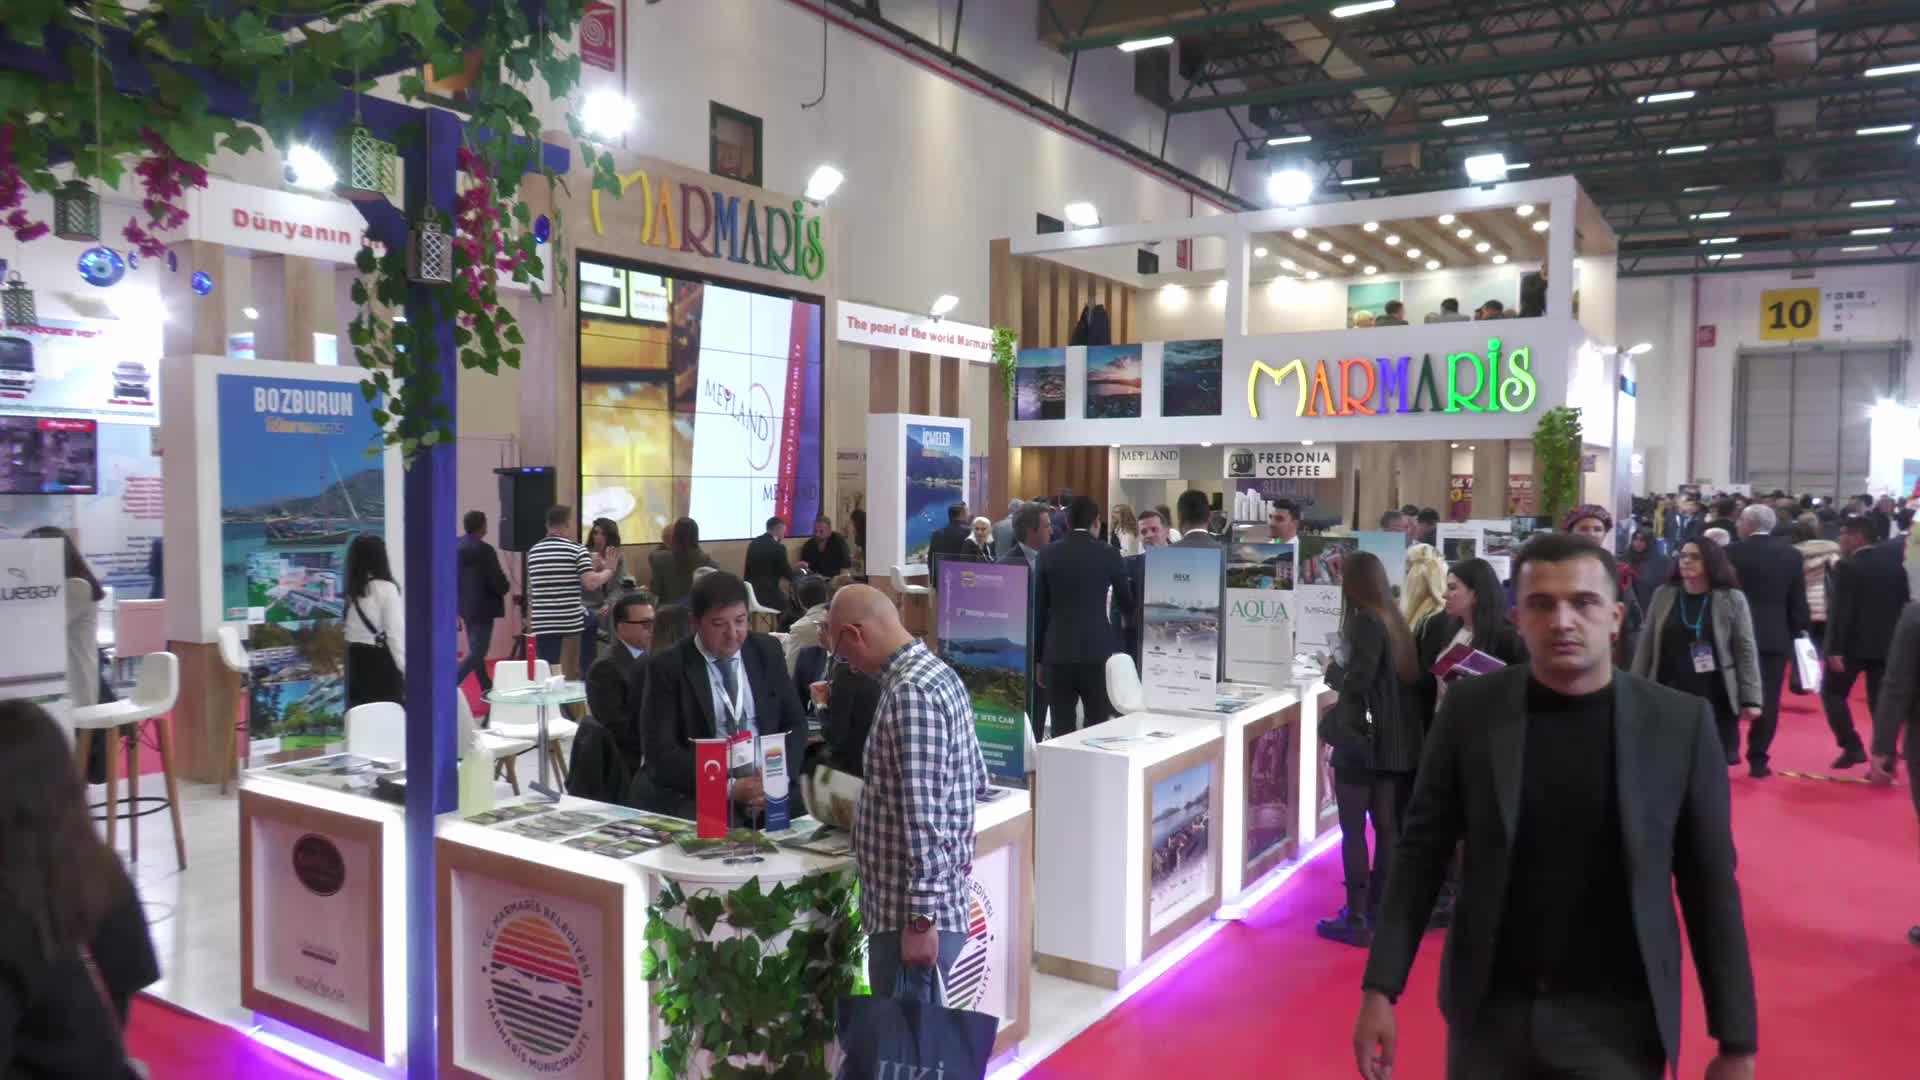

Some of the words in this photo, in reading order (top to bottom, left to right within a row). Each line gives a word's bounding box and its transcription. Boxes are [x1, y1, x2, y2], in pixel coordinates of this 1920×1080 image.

[232, 207, 351, 245] Dünyanın
[1768, 300, 1813, 329] 10
[847, 315, 868, 331] The
[870, 322, 897, 337] pearl
[899, 325, 910, 337] of
[911, 327, 928, 341] the
[929, 331, 955, 346] world
[957, 335, 993, 350] Marmari
[253, 387, 354, 417] BOZBURUN
[704, 377, 769, 441] MEYLAND
[1120, 450, 1178, 461] MEYLAND
[1258, 452, 1331, 464] FREDONIA
[1266, 465, 1321, 477] COFFEE
[1229, 599, 1289, 623] AQUA
